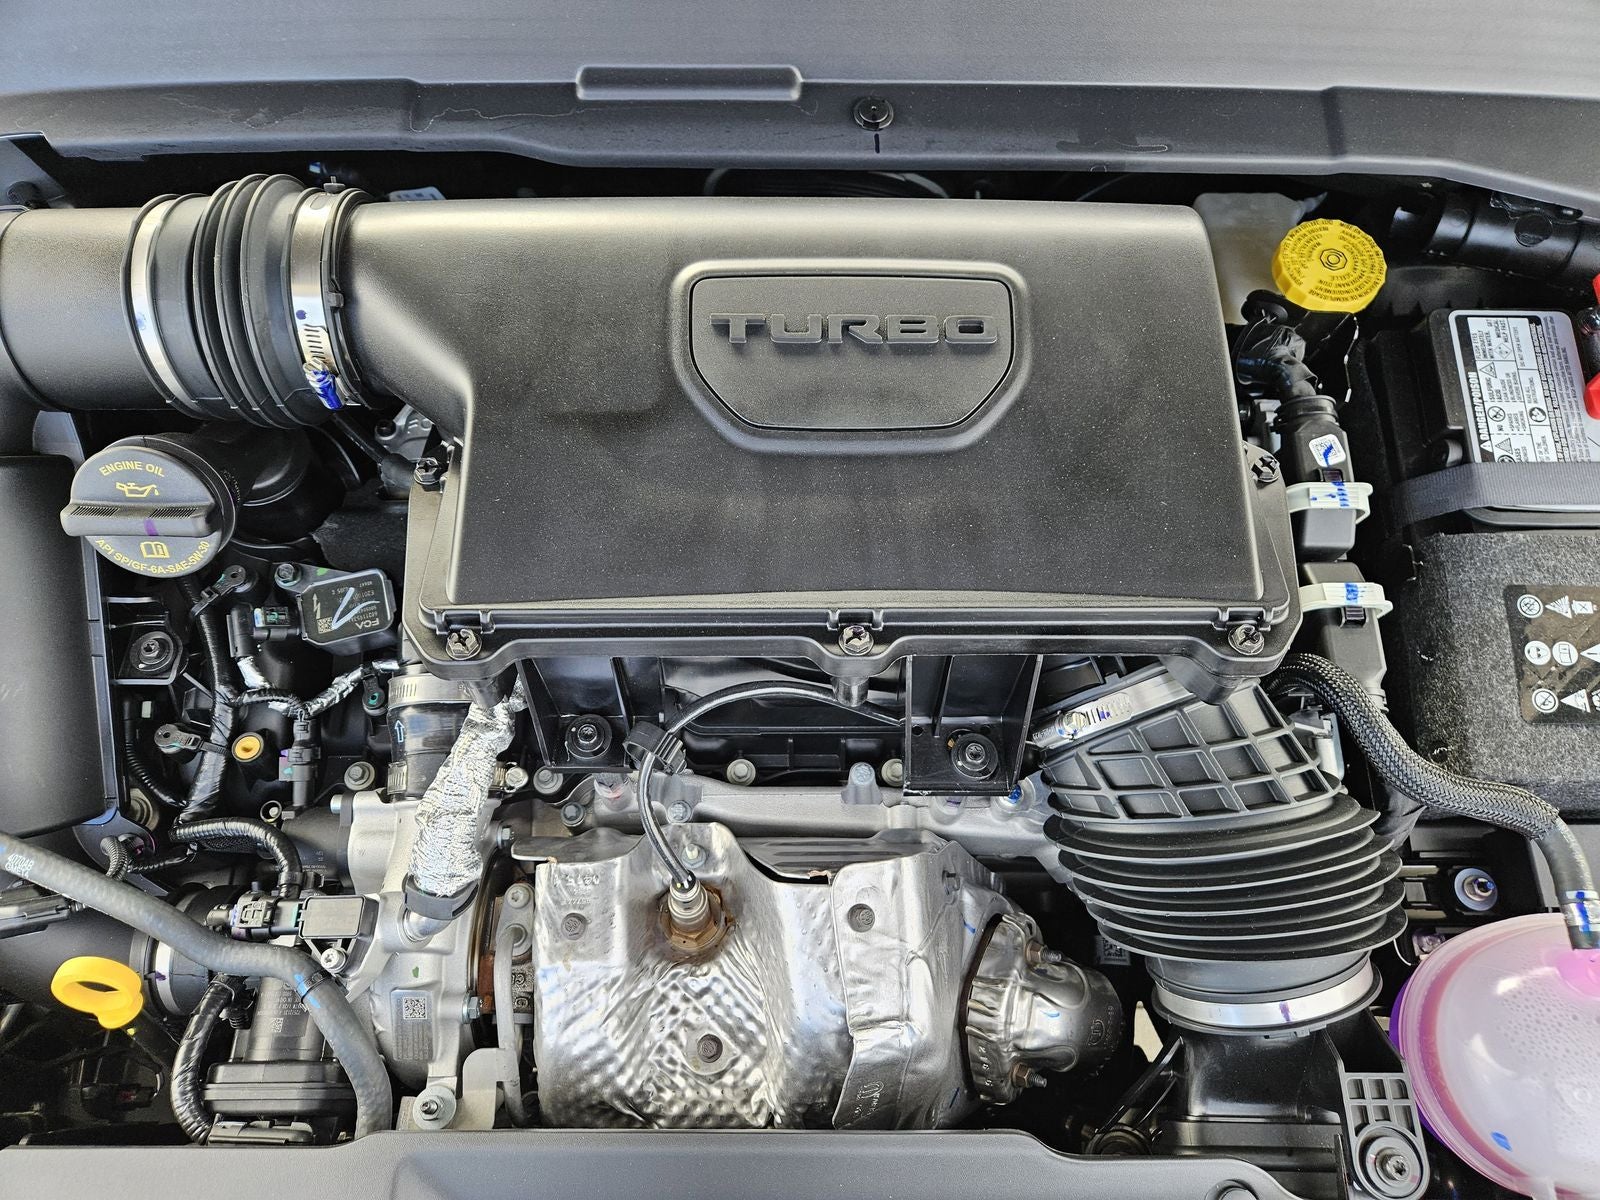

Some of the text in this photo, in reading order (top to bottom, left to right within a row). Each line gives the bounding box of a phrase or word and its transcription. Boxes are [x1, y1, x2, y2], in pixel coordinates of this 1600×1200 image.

[710, 313, 998, 345] TURBO
[1467, 371, 1490, 440] DANGER/POISON
[98, 460, 165, 478] ENGINE OIL
[96, 538, 114, 555] API
[355, 618, 380, 630] FCA
